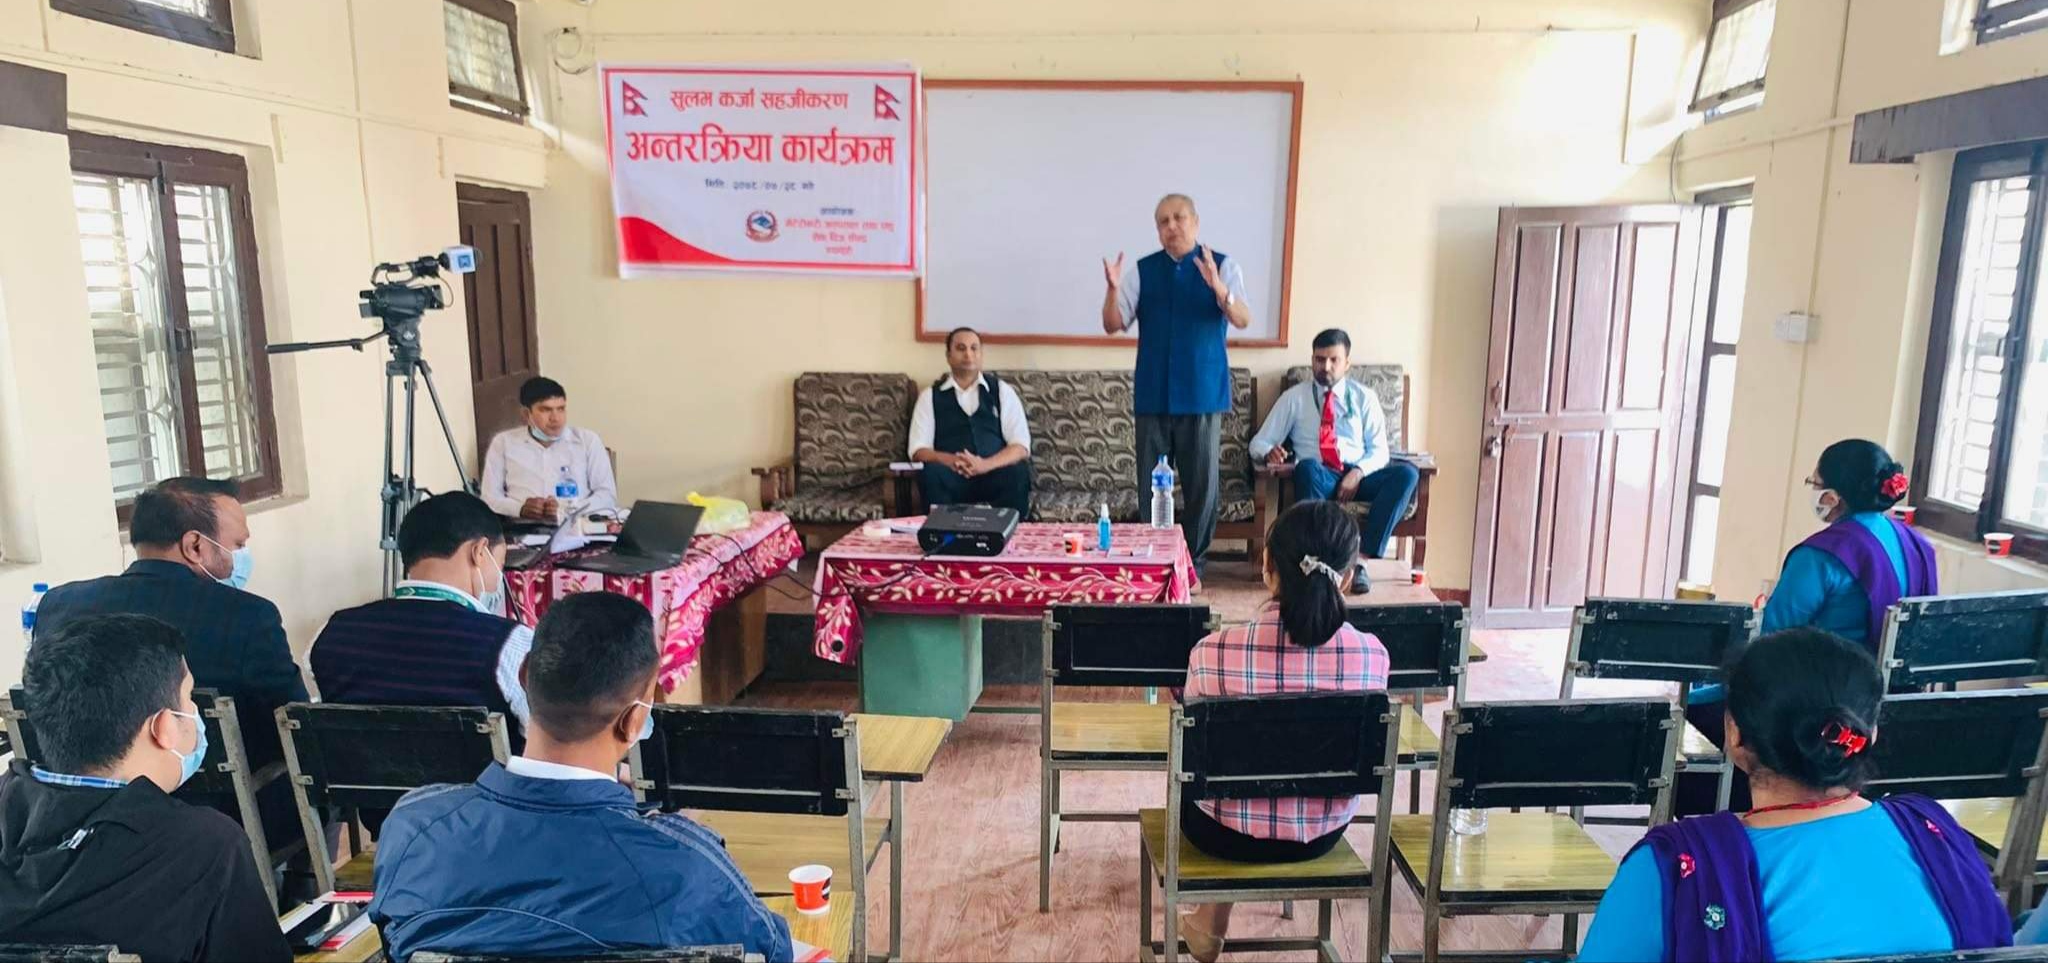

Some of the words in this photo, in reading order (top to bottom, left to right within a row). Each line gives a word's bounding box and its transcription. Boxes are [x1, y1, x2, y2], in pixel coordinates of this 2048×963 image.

[671, 90, 713, 112] सुलभ
[718, 87, 755, 108] कर्जा
[761, 87, 849, 109] सहजीकरण
[625, 122, 774, 163] अन्तरक्रिया
[780, 126, 897, 166] कार्यक्रम
